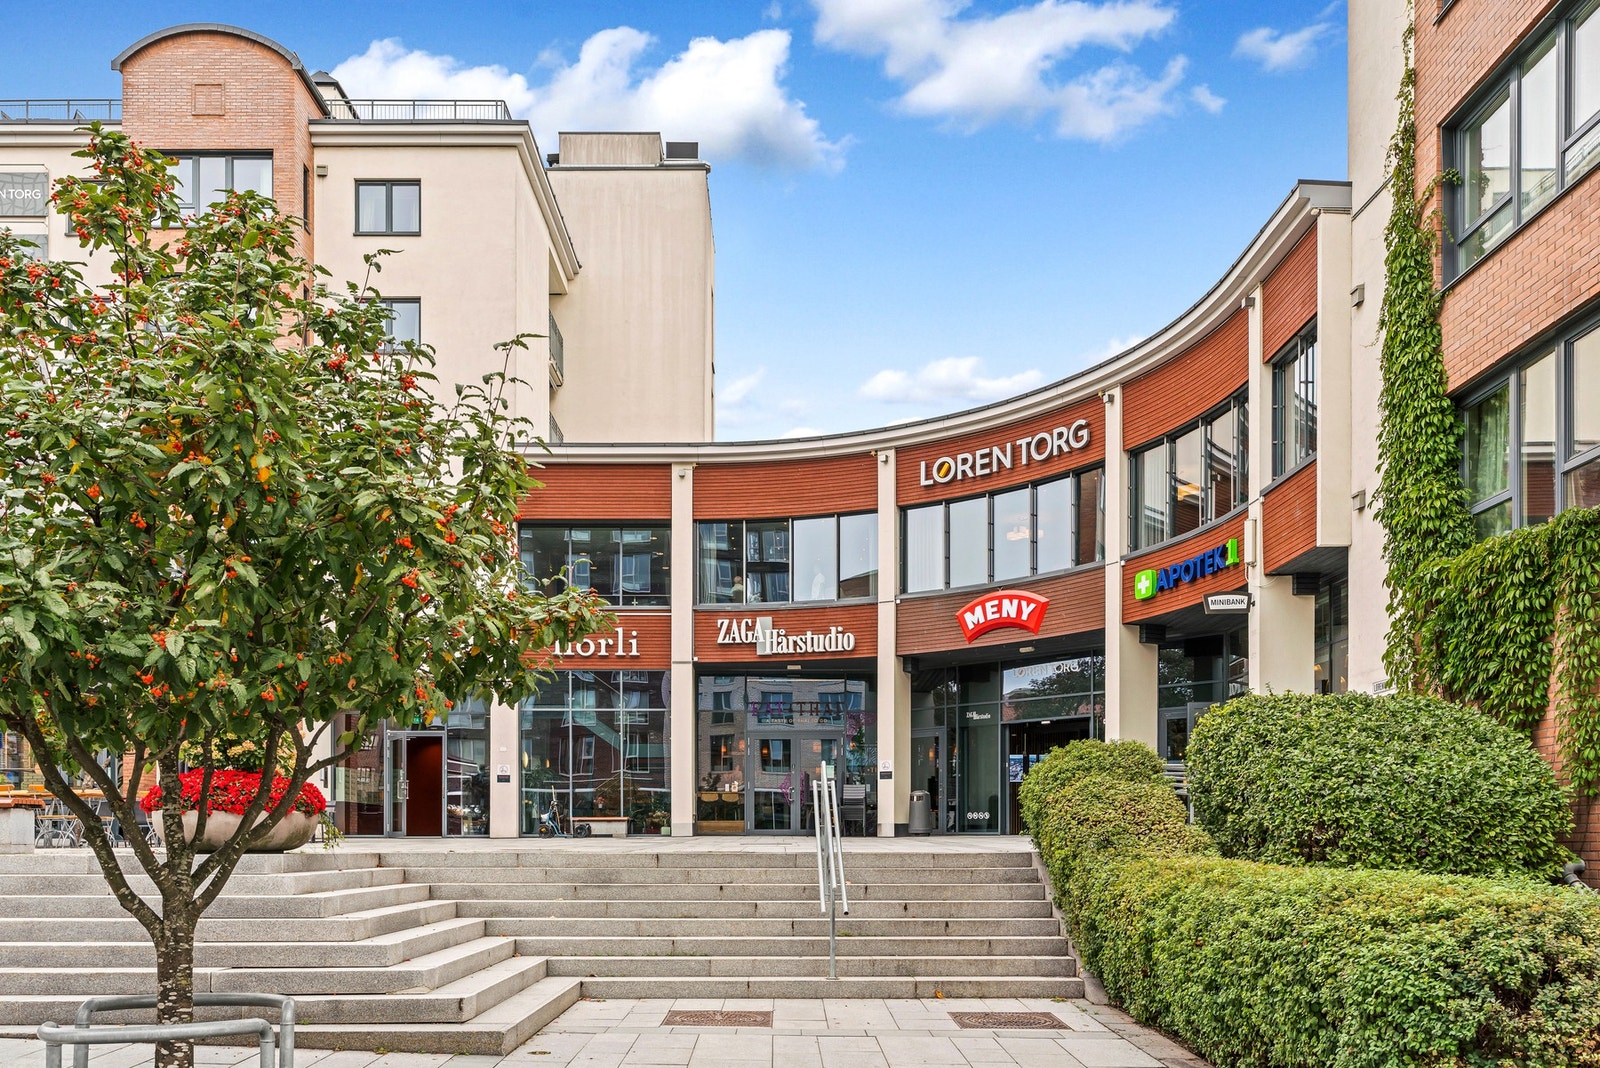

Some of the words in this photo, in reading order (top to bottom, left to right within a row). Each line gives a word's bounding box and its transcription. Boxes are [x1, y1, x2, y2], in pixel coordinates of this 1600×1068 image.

[9, 188, 42, 200] TORG
[1016, 418, 1091, 466] TORG
[1156, 544, 1226, 592] APOTEK
[1224, 538, 1240, 567] 1
[963, 598, 1038, 631] MENY
[1210, 598, 1246, 606] MINIBANK
[717, 618, 766, 644] ZAGA
[764, 626, 856, 654] Hårstudio
